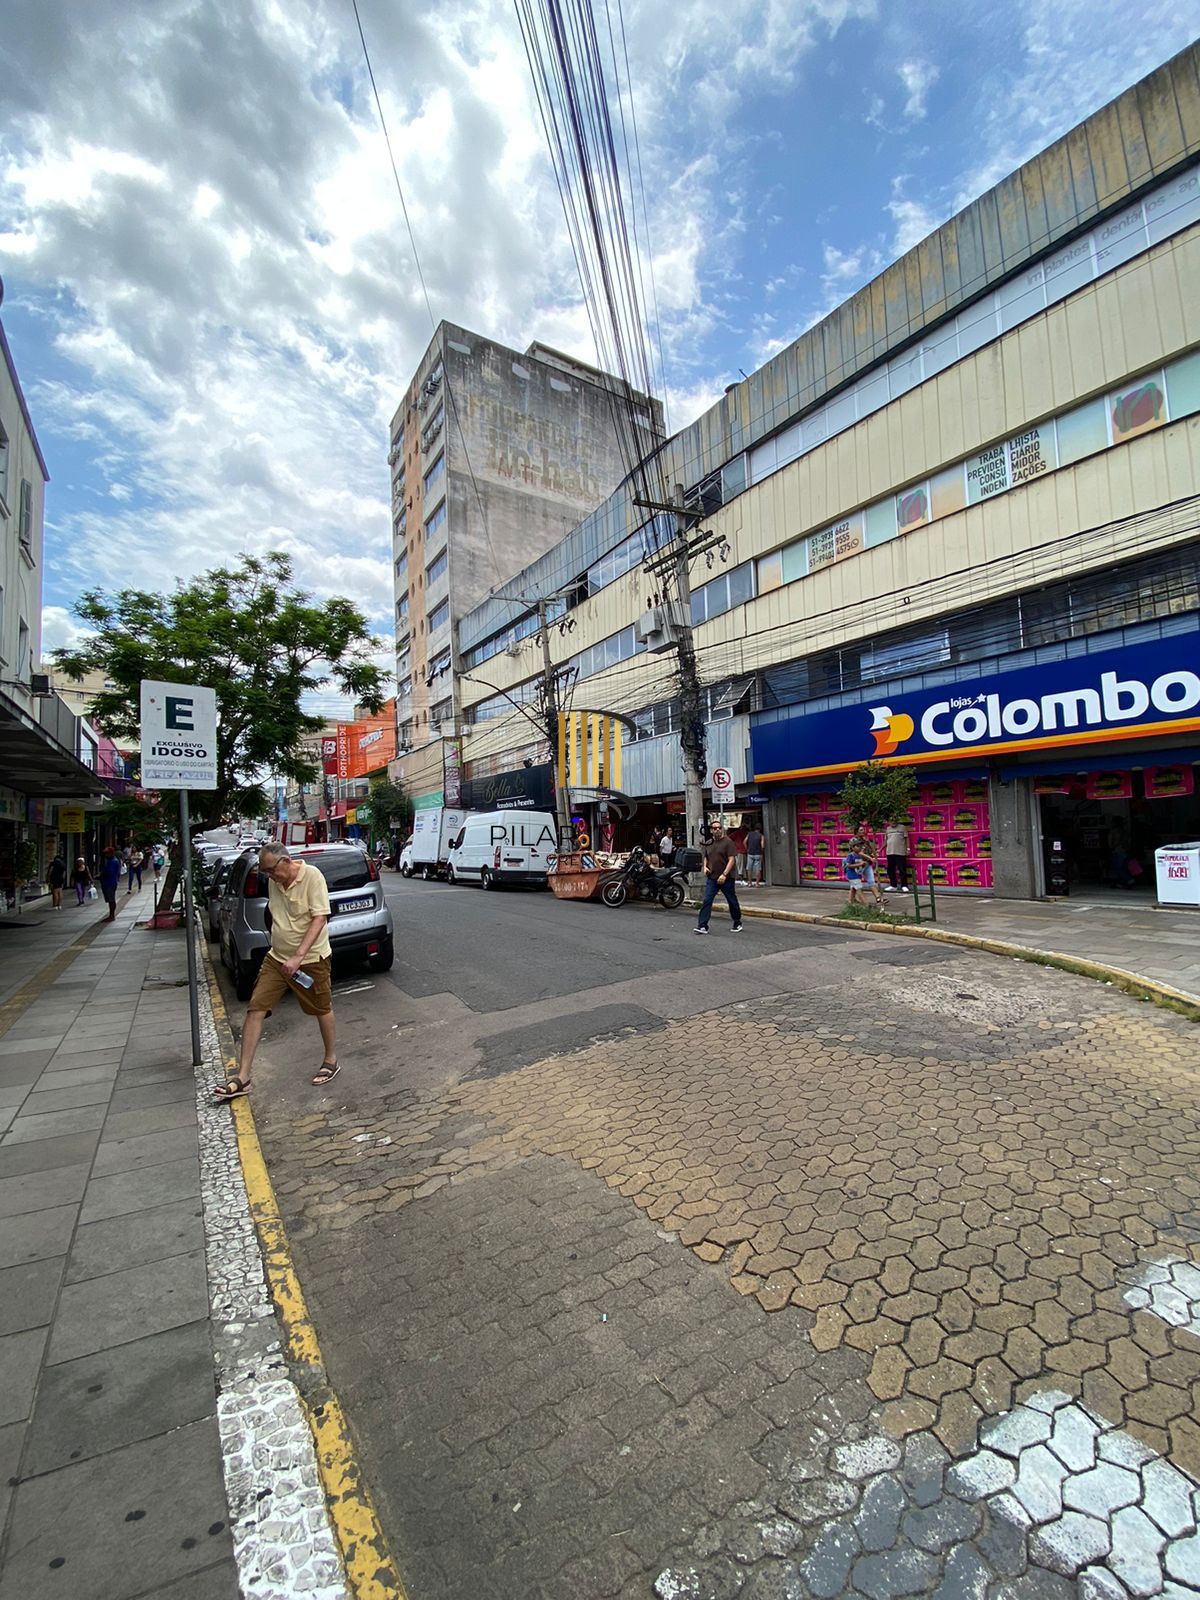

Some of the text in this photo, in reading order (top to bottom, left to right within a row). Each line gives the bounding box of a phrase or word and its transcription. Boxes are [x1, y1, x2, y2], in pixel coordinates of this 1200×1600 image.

[967, 440, 1040, 482] PREVIDEN CIÁRIO
[978, 429, 1040, 465] TRABA LHISTA
[979, 451, 1041, 486] CONSU MIDOR
[980, 460, 1047, 496] INDENI ZAÇÕES
[166, 696, 194, 731] E
[920, 670, 1200, 746] Colombo
[951, 696, 972, 709] lojas
[151, 746, 207, 758] IDOSO
[339, 726, 347, 777] ORTHOPRIDE
